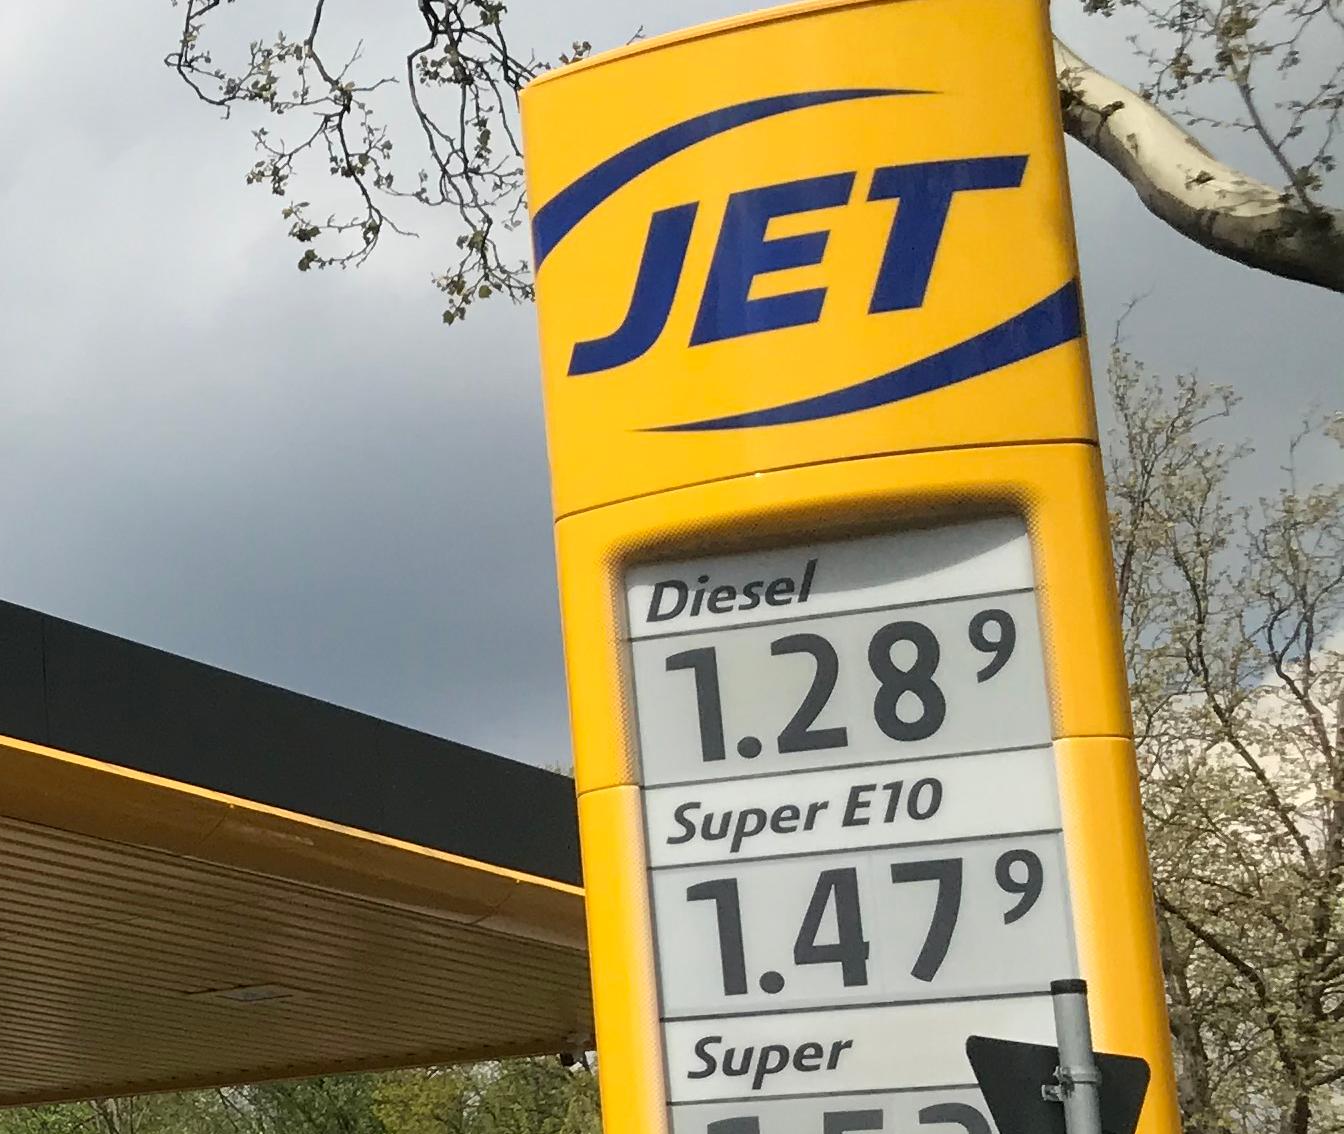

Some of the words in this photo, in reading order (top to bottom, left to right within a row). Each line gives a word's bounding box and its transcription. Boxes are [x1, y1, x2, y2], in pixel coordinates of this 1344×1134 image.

[566, 154, 1029, 377] JET
[645, 558, 819, 623] Diesel
[666, 797, 829, 854] Super
[841, 777, 943, 829] E10
[687, 1036, 853, 1090] Super
